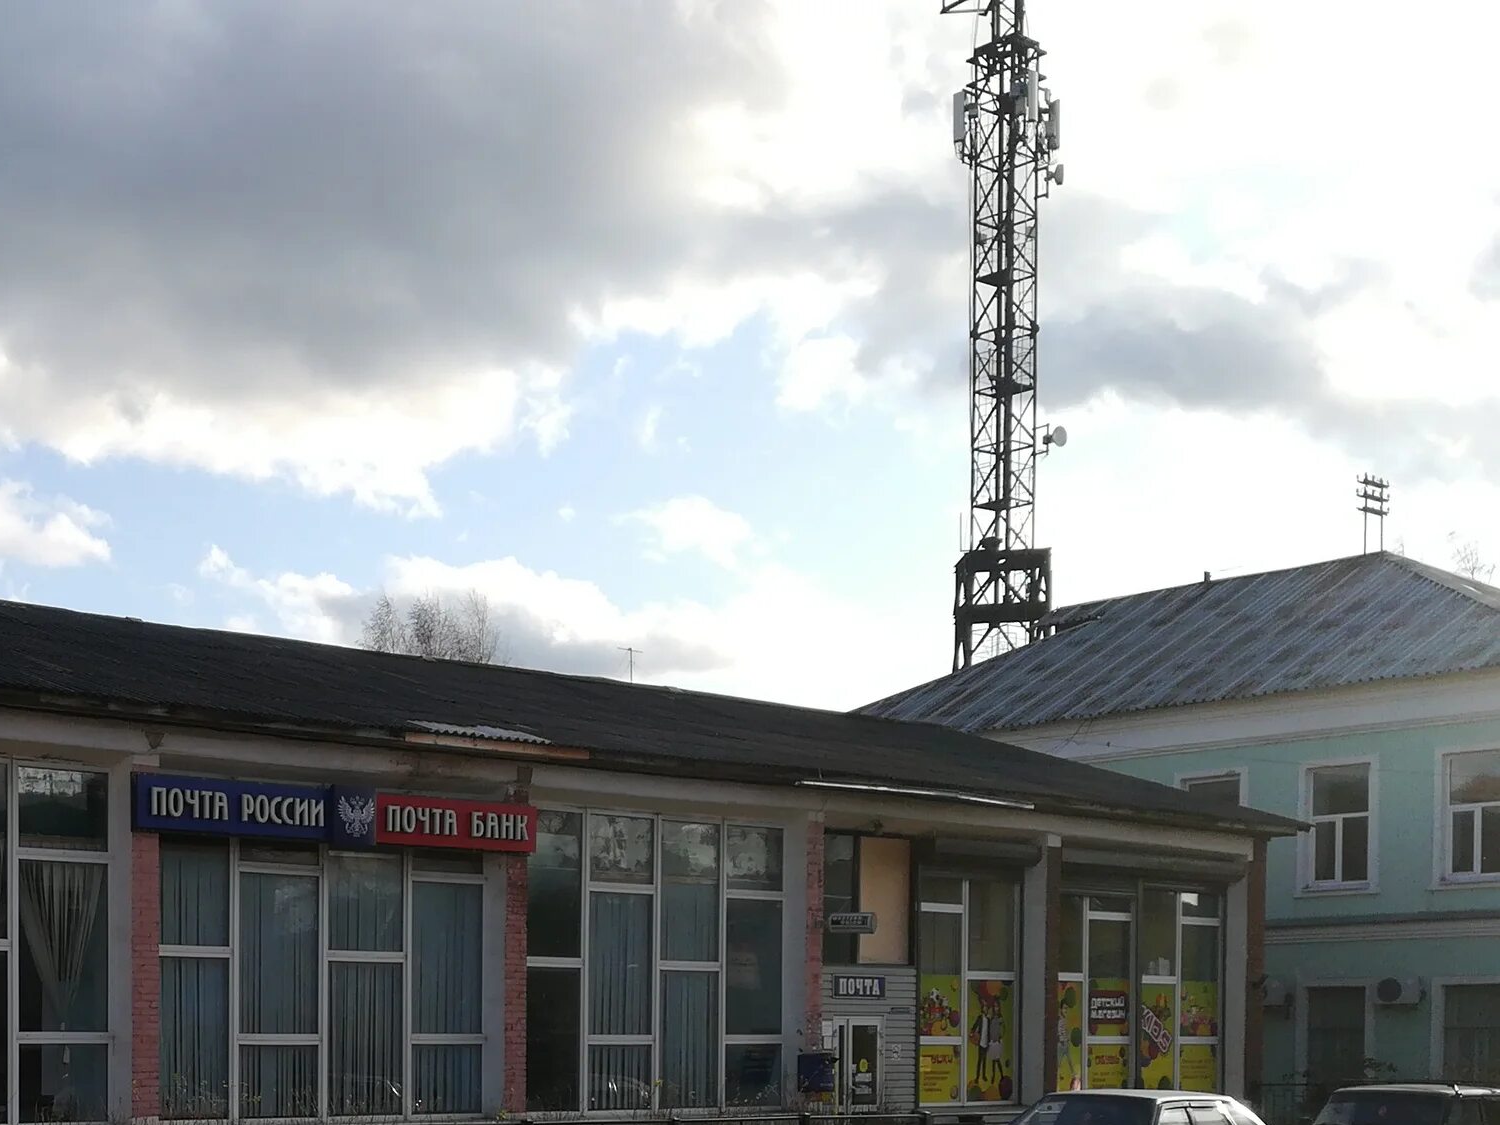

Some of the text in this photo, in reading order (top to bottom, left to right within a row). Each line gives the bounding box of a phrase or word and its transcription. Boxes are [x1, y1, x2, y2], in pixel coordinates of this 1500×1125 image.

[149, 785, 326, 828] ПОЧТА РОССИИ
[386, 803, 530, 841] ПОЧТА БАНК
[838, 978, 881, 996] ПОЧТА
